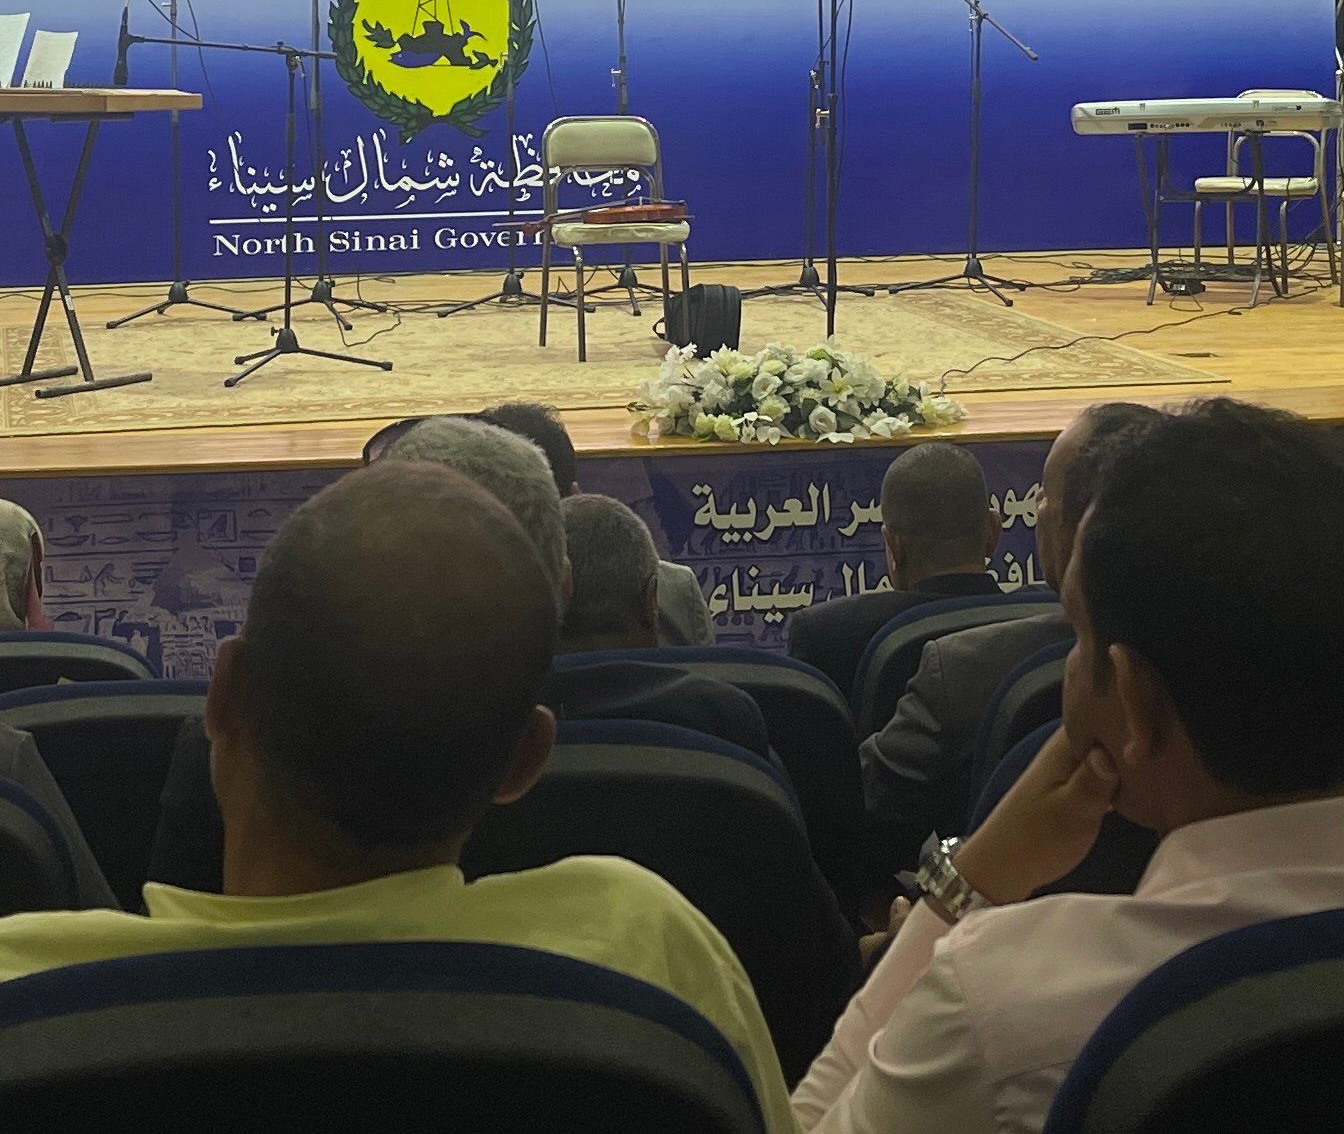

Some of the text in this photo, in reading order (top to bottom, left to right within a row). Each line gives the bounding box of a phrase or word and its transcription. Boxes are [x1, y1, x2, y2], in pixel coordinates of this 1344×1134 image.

[208, 131, 317, 214] سيناء
[323, 132, 460, 208] شمال
[212, 233, 315, 256] North
[329, 229, 420, 253] Sinai
[692, 482, 831, 544] العربية
[709, 563, 814, 623] سيناء
